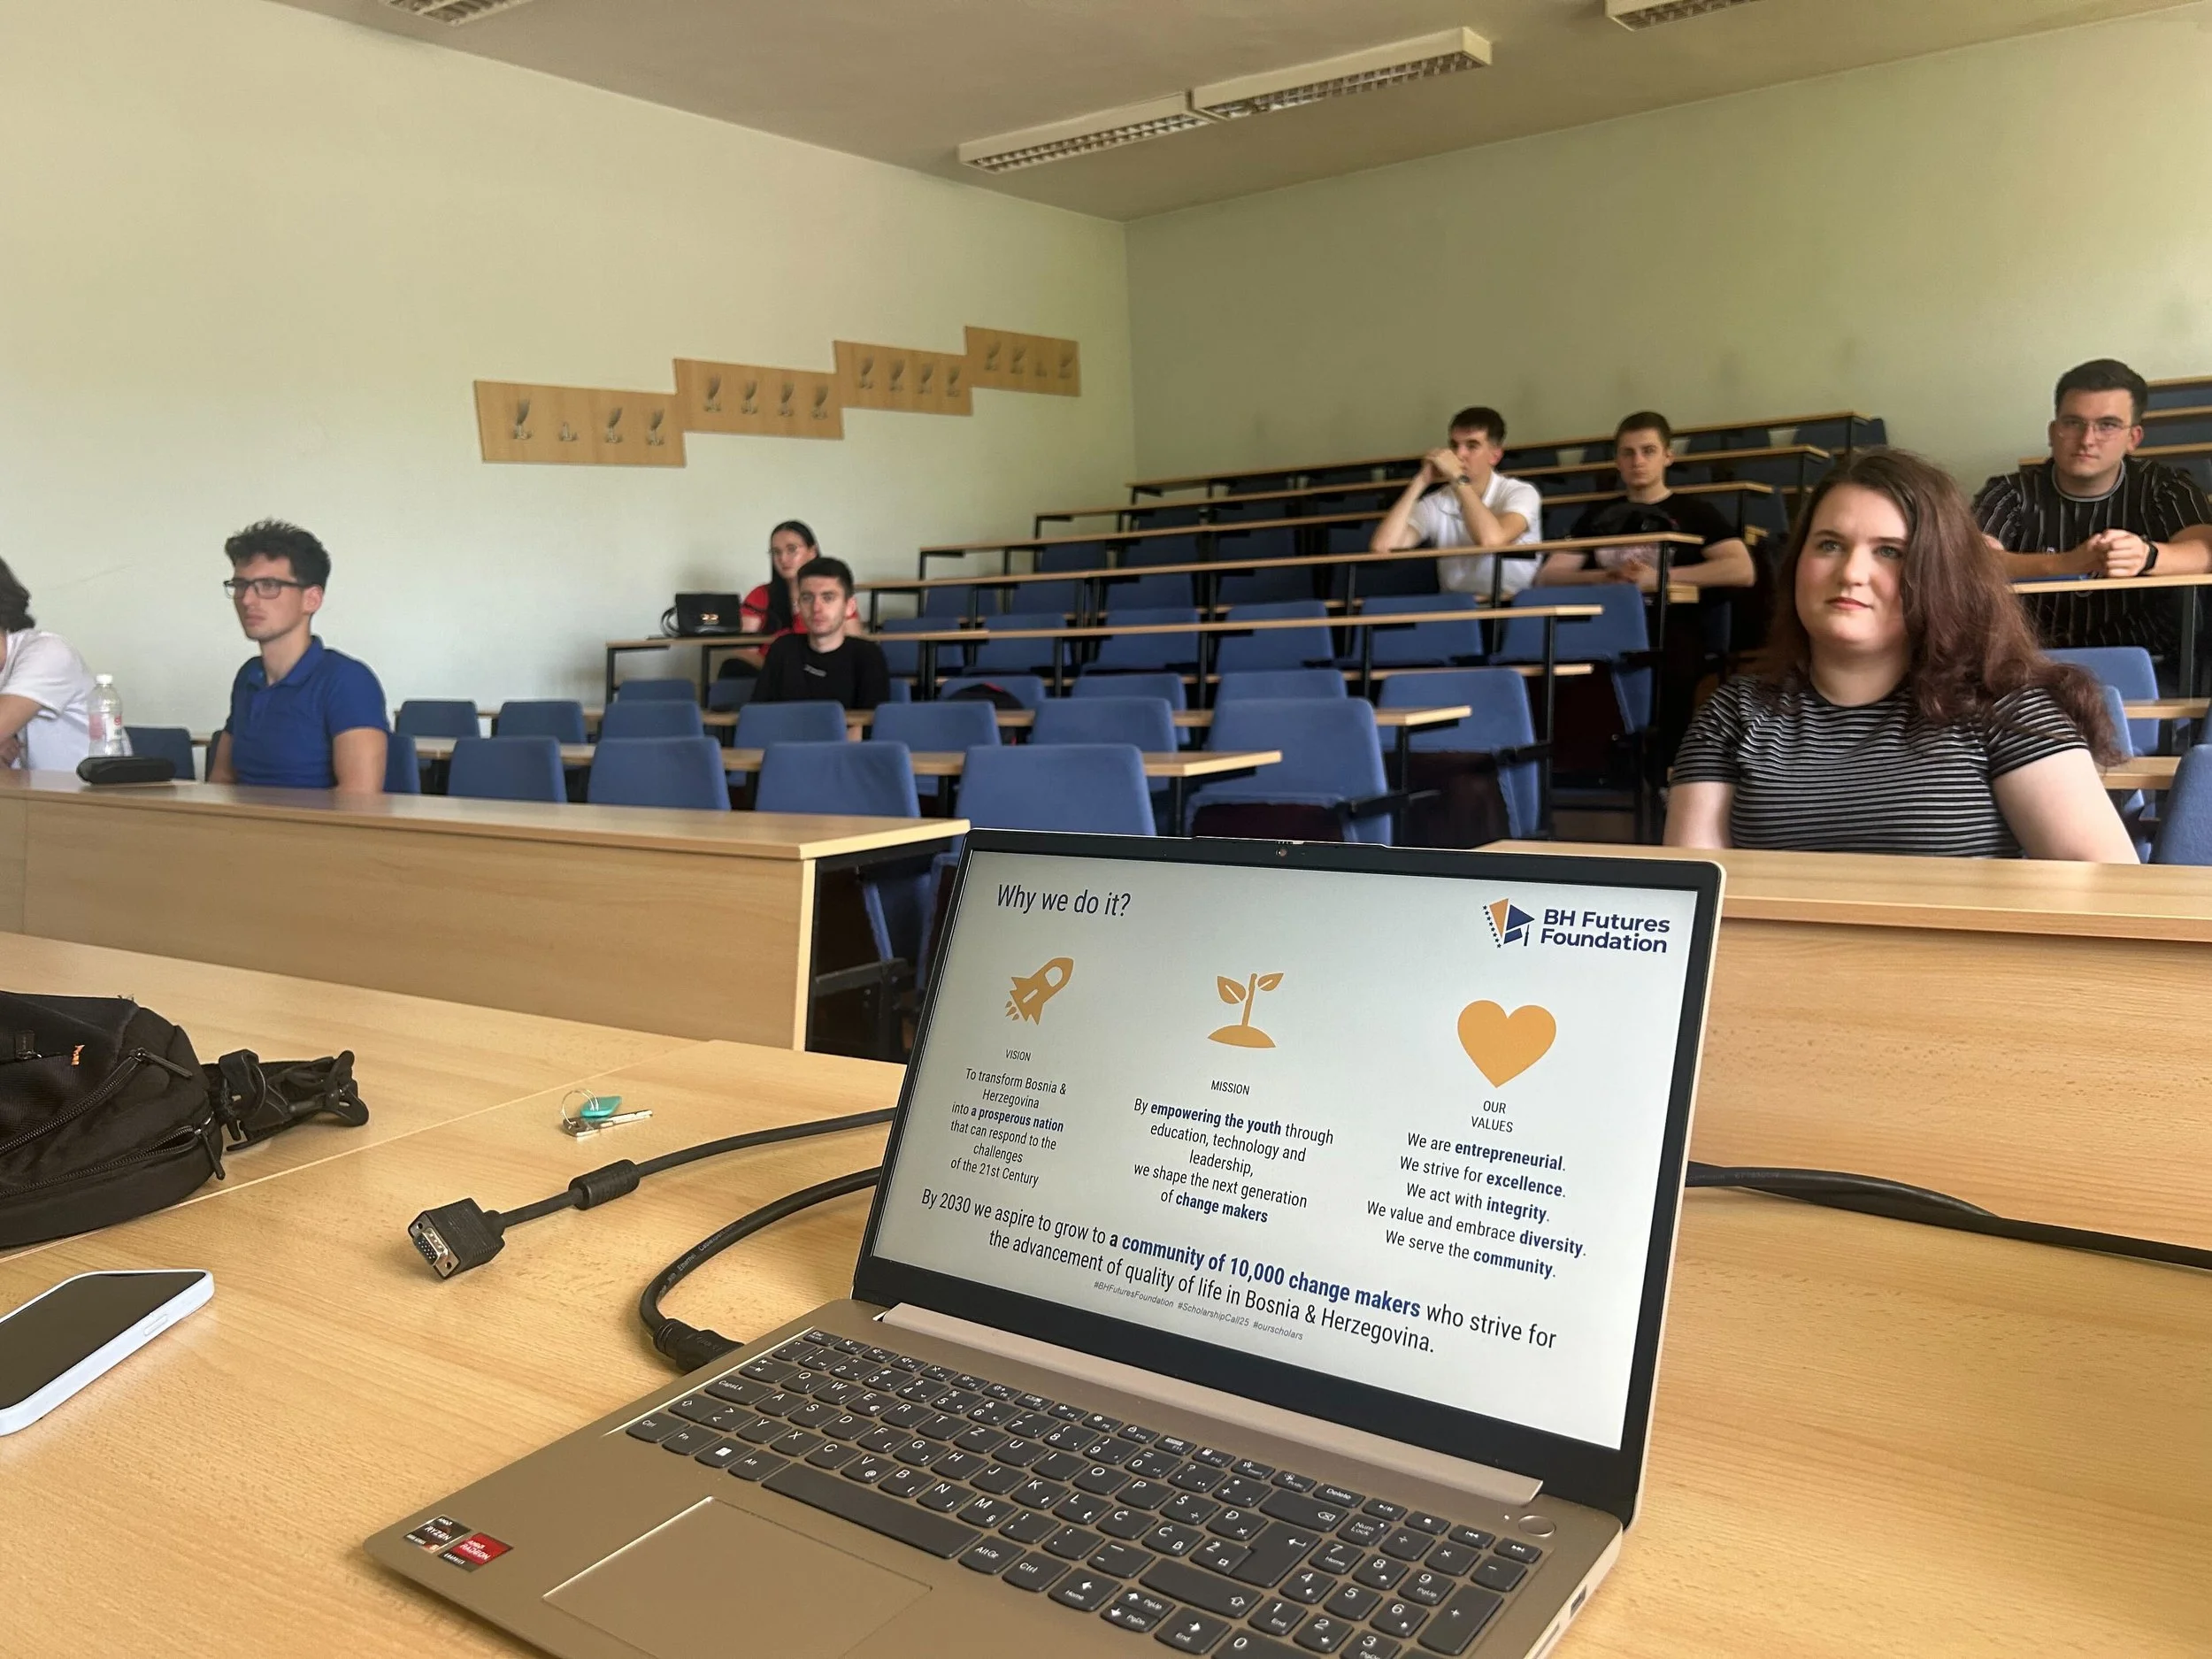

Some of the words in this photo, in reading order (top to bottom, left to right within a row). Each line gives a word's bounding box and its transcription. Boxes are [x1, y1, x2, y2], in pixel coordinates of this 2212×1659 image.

[997, 884, 1037, 915] Why
[1041, 893, 1069, 912] we
[1073, 888, 1099, 914] do
[1104, 891, 1132, 917] it?
[1543, 909, 1576, 926] BH
[1581, 910, 1671, 933] Futures
[1540, 927, 1667, 954] Foundation
[1005, 1048, 1032, 1062] VISION
[966, 1067, 977, 1080] To
[978, 1071, 1023, 1088] transform
[1025, 1077, 1057, 1094] Bosnia
[1059, 1083, 1067, 1095] &
[1210, 1079, 1250, 1095] MISSION
[982, 1088, 1040, 1110] Herzegovina
[1483, 1100, 1507, 1114] OUR
[951, 1103, 970, 1116] into
[971, 1107, 977, 1117] a
[977, 1109, 1032, 1126] prosperous
[1033, 1118, 1064, 1133] nation
[1133, 1097, 1148, 1116] By
[1150, 1103, 1222, 1128] empowering
[1225, 1112, 1244, 1129] the
[1246, 1119, 1282, 1136] youth
[1285, 1123, 1333, 1147] through
[1471, 1116, 1514, 1133] VALUES
[950, 1118, 969, 1134] that
[970, 1125, 987, 1138] can
[988, 1129, 1028, 1145] respond
[1028, 1134, 1039, 1147] to
[1041, 1135, 1057, 1150] the
[1150, 1122, 1209, 1148] education,
[1212, 1133, 1280, 1160] technology
[1282, 1147, 1307, 1163] and
[972, 1142, 1024, 1164] challenges
[1408, 1132, 1427, 1148] We
[1430, 1139, 1451, 1152] are
[1455, 1143, 1565, 1171] entrepreneurial.
[1189, 1148, 1254, 1178] leadership,
[950, 1156, 963, 1170] of
[962, 1158, 978, 1173] the
[979, 1162, 1001, 1179] 21st
[1002, 1167, 1040, 1189] Century
[1400, 1156, 1419, 1172] We
[1423, 1162, 1460, 1179] strive
[1463, 1165, 1483, 1183] for
[1486, 1173, 1565, 1198] excellence.
[1134, 1164, 1150, 1177] we
[1152, 1165, 1187, 1186] shape
[1190, 1171, 1210, 1188] the
[1211, 1179, 1239, 1194] next
[1240, 1185, 1308, 1209] generation
[1160, 1188, 1175, 1203] of
[1175, 1191, 1219, 1215] change
[1221, 1203, 1269, 1223] makers
[1407, 1182, 1426, 1199] We
[1429, 1189, 1451, 1203] act
[1455, 1193, 1483, 1210] with
[1486, 1196, 1549, 1225] integrity.
[1367, 1200, 1386, 1217] We
[1390, 1206, 1424, 1225] value
[1427, 1215, 1453, 1231] and
[1455, 1220, 1516, 1242] embrace
[1519, 1229, 1586, 1259] diversity.
[1386, 1229, 1405, 1247] We
[1408, 1237, 1444, 1255] serve
[1448, 1241, 1470, 1260] the
[1473, 1250, 1555, 1280] community.
[921, 1188, 938, 1210] By
[939, 1192, 972, 1214] 2030
[974, 1202, 992, 1218] we
[995, 1208, 1035, 1228] aspire
[1038, 1214, 1052, 1233] to
[1054, 1221, 1089, 1240] grow
[1092, 1226, 1106, 1245] to
[1109, 1233, 1118, 1248] a
[1121, 1236, 1206, 1271] community
[1208, 1253, 1227, 1272] of
[1231, 1257, 1285, 1286] 10,000
[1288, 1271, 1350, 1303] change
[1354, 1289, 1421, 1317] makers
[1426, 1303, 1463, 1327] who
[1469, 1314, 1522, 1341] strive
[1528, 1323, 1557, 1348] for
[989, 1229, 1010, 1249] the
[1012, 1236, 1104, 1272] advancement
[1106, 1257, 1124, 1276] of
[1125, 1265, 1175, 1293] quality
[1178, 1275, 1196, 1294] of
[1197, 1277, 1223, 1301] life
[1225, 1284, 1240, 1306] in
[1245, 1289, 1300, 1320] Bosnia
[1304, 1304, 1317, 1325] &
[1321, 1307, 1434, 1353] Herzegovina.
[1094, 1280, 1174, 1308] #BHFuturesFoundation
[1177, 1302, 1250, 1327] #ScholarshipCall25
[1252, 1320, 1303, 1340] #ourscholars
[863, 1392, 877, 1401] E
[897, 1403, 911, 1412] R
[757, 1418, 771, 1427] Y
[787, 1431, 803, 1440] X
[970, 1427, 986, 1436] Z
[911, 1440, 926, 1449] G
[1010, 1440, 1024, 1448] U
[949, 1453, 964, 1463] H
[895, 1470, 910, 1479] B
[1091, 1467, 1105, 1477] O
[934, 1483, 951, 1494] N
[1027, 1479, 1043, 1490] K
[1132, 1480, 1147, 1489] P
[1070, 1494, 1080, 1504] L
[1325, 1487, 1351, 1500] Delete
[975, 1498, 993, 1509] M
[425, 1525, 452, 1541] RYZEN
[1350, 1525, 1371, 1537] Lock
[1355, 1521, 1374, 1532] Num
[459, 1543, 491, 1560] RADEON
[975, 1546, 1000, 1559] AltGr
[1019, 1562, 1039, 1574] Ctrl
[1372, 1559, 1386, 1570] 8
[1418, 1573, 1432, 1585] 9
[1344, 1587, 1359, 1599] 5
[1391, 1603, 1406, 1616] 6
[1271, 1617, 1286, 1628] End
[1314, 1618, 1330, 1630] 2
[1175, 1632, 1192, 1643] End
